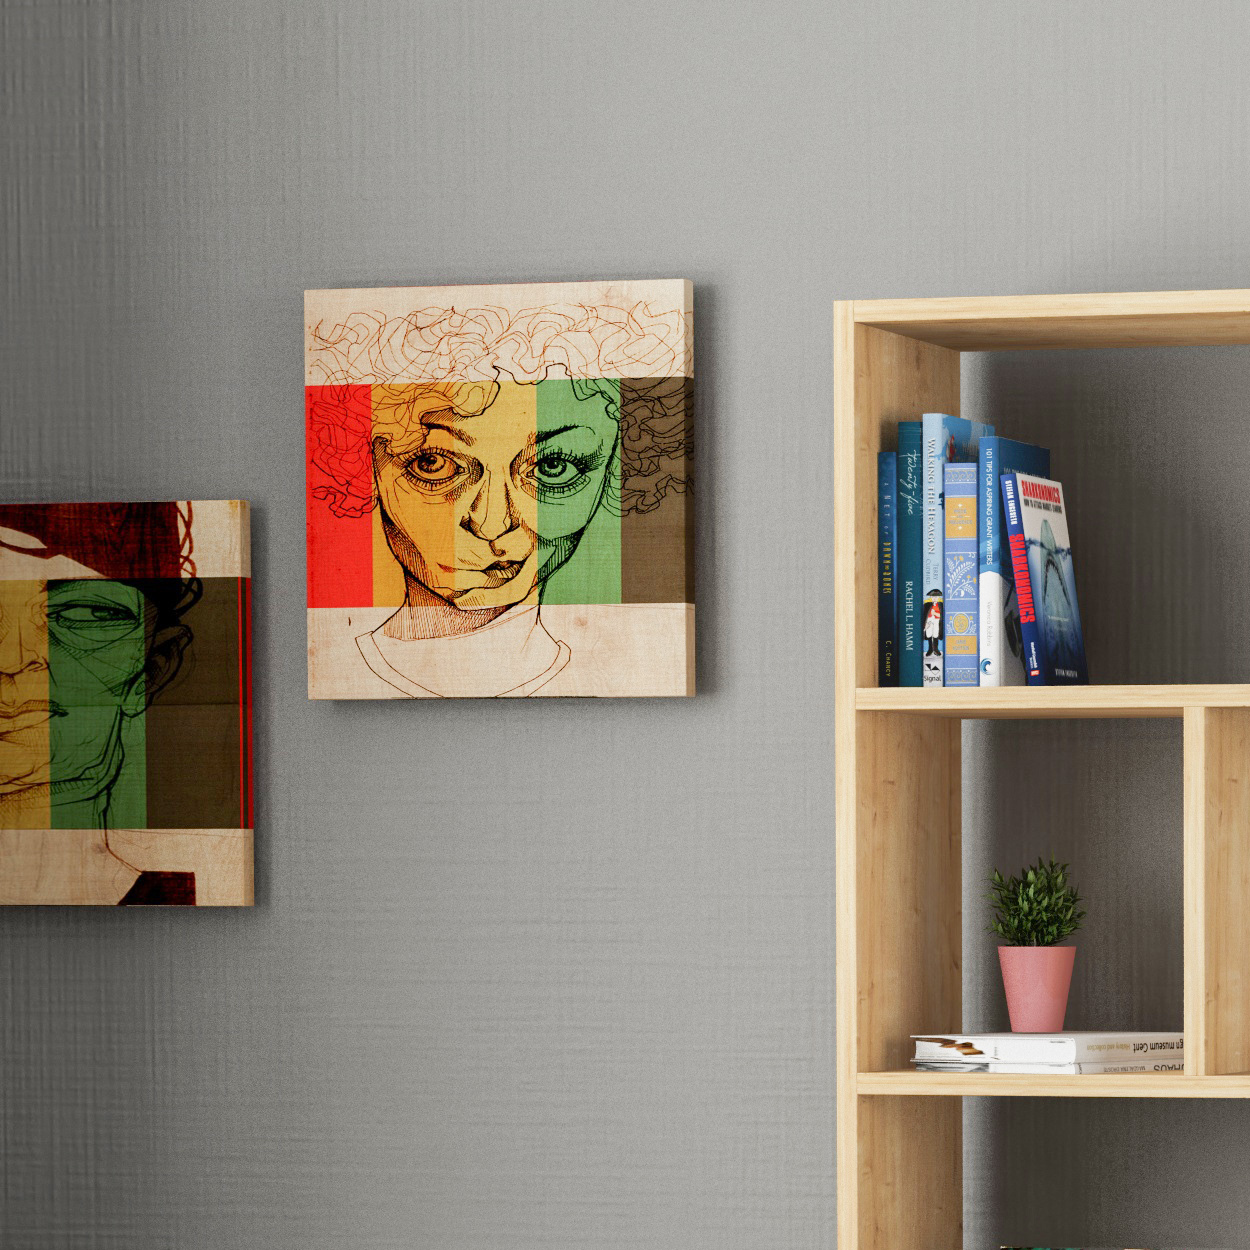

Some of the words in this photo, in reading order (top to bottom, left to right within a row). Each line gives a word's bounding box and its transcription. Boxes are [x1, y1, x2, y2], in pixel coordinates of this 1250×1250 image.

[928, 437, 936, 484] WALKING
[928, 486, 936, 504] THE
[928, 508, 936, 555] HEXAGON
[1009, 533, 1037, 624] SHARKONOMICS
[905, 581, 914, 612] RACHEL
[905, 623, 914, 651] HAMM
[923, 675, 941, 684] Signal
[1150, 1041, 1175, 1050] museum
